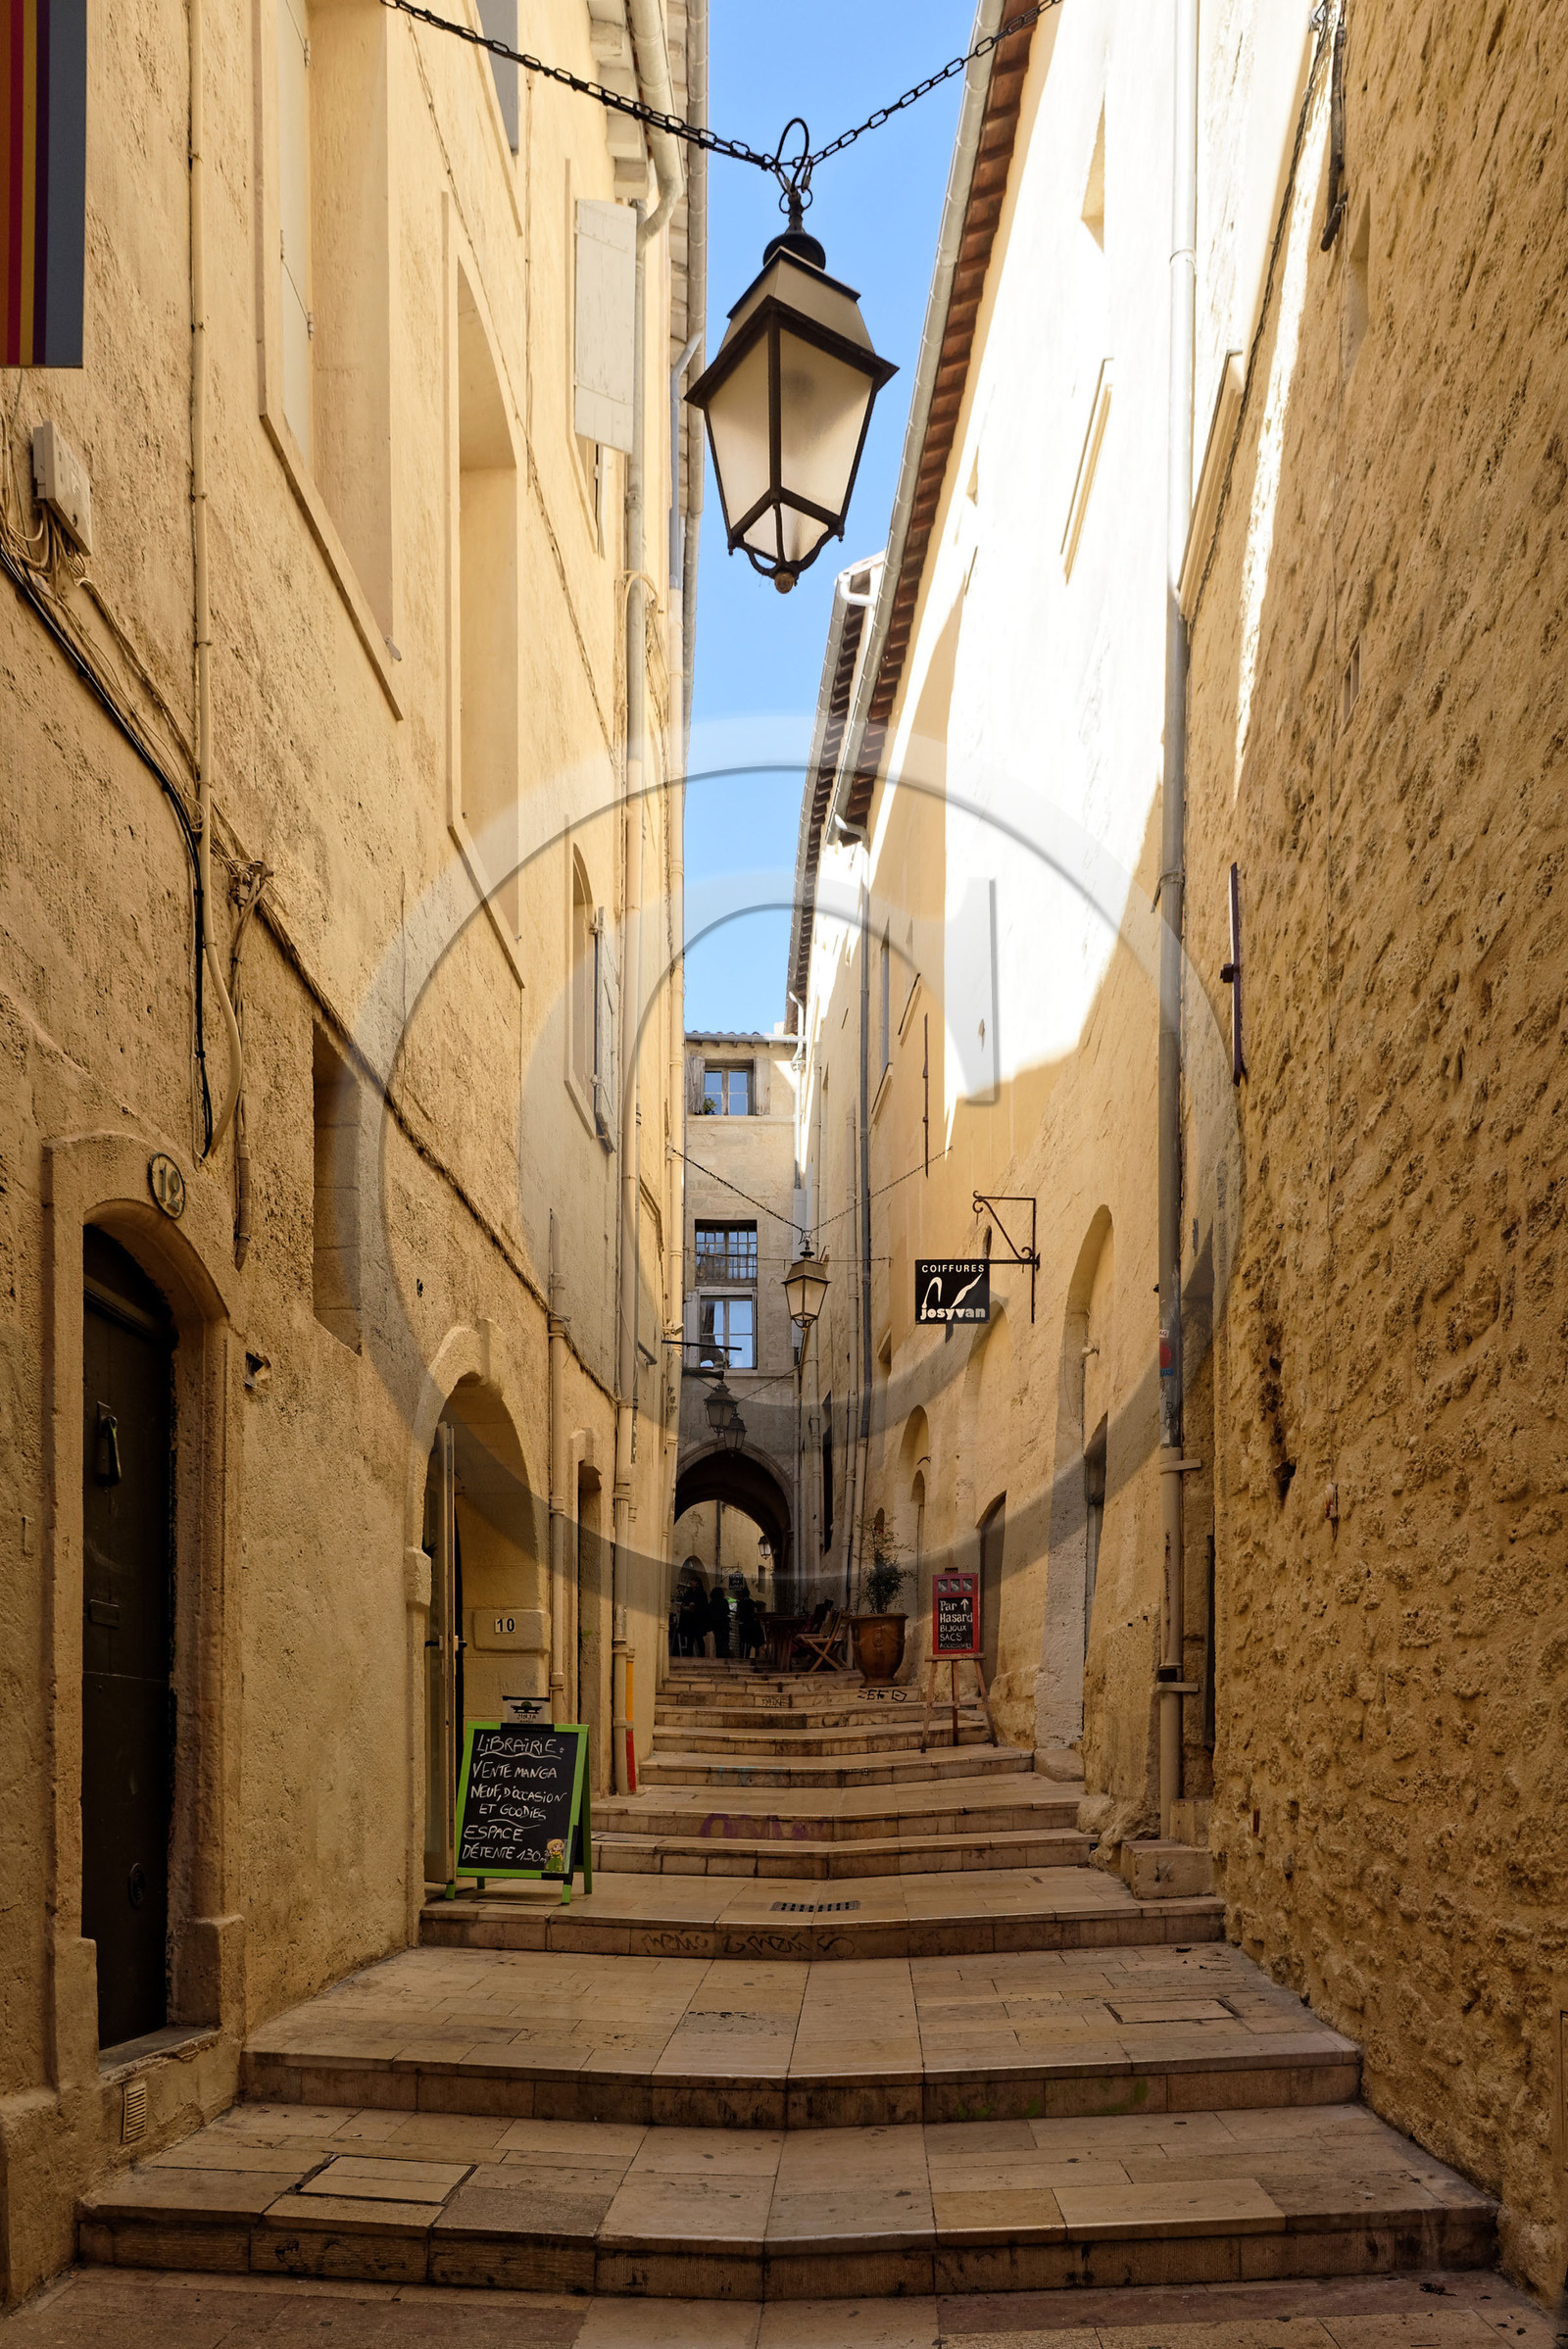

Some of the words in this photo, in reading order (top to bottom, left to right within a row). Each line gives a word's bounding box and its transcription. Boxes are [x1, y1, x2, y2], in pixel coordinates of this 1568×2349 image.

[160, 1163, 180, 1211] 12
[921, 1264, 985, 1273] COIFFURES
[920, 1306, 986, 1320] josyvan
[940, 1600, 957, 1611] Par
[940, 1612, 973, 1624] Hasard
[496, 1618, 514, 1633] 10
[472, 1760, 511, 1779] VENTE
[514, 1766, 558, 1780] MANGA
[479, 1803, 497, 1814] ET
[464, 1825, 524, 1841] ESPACE
[462, 1842, 516, 1860] DÉTENTE
